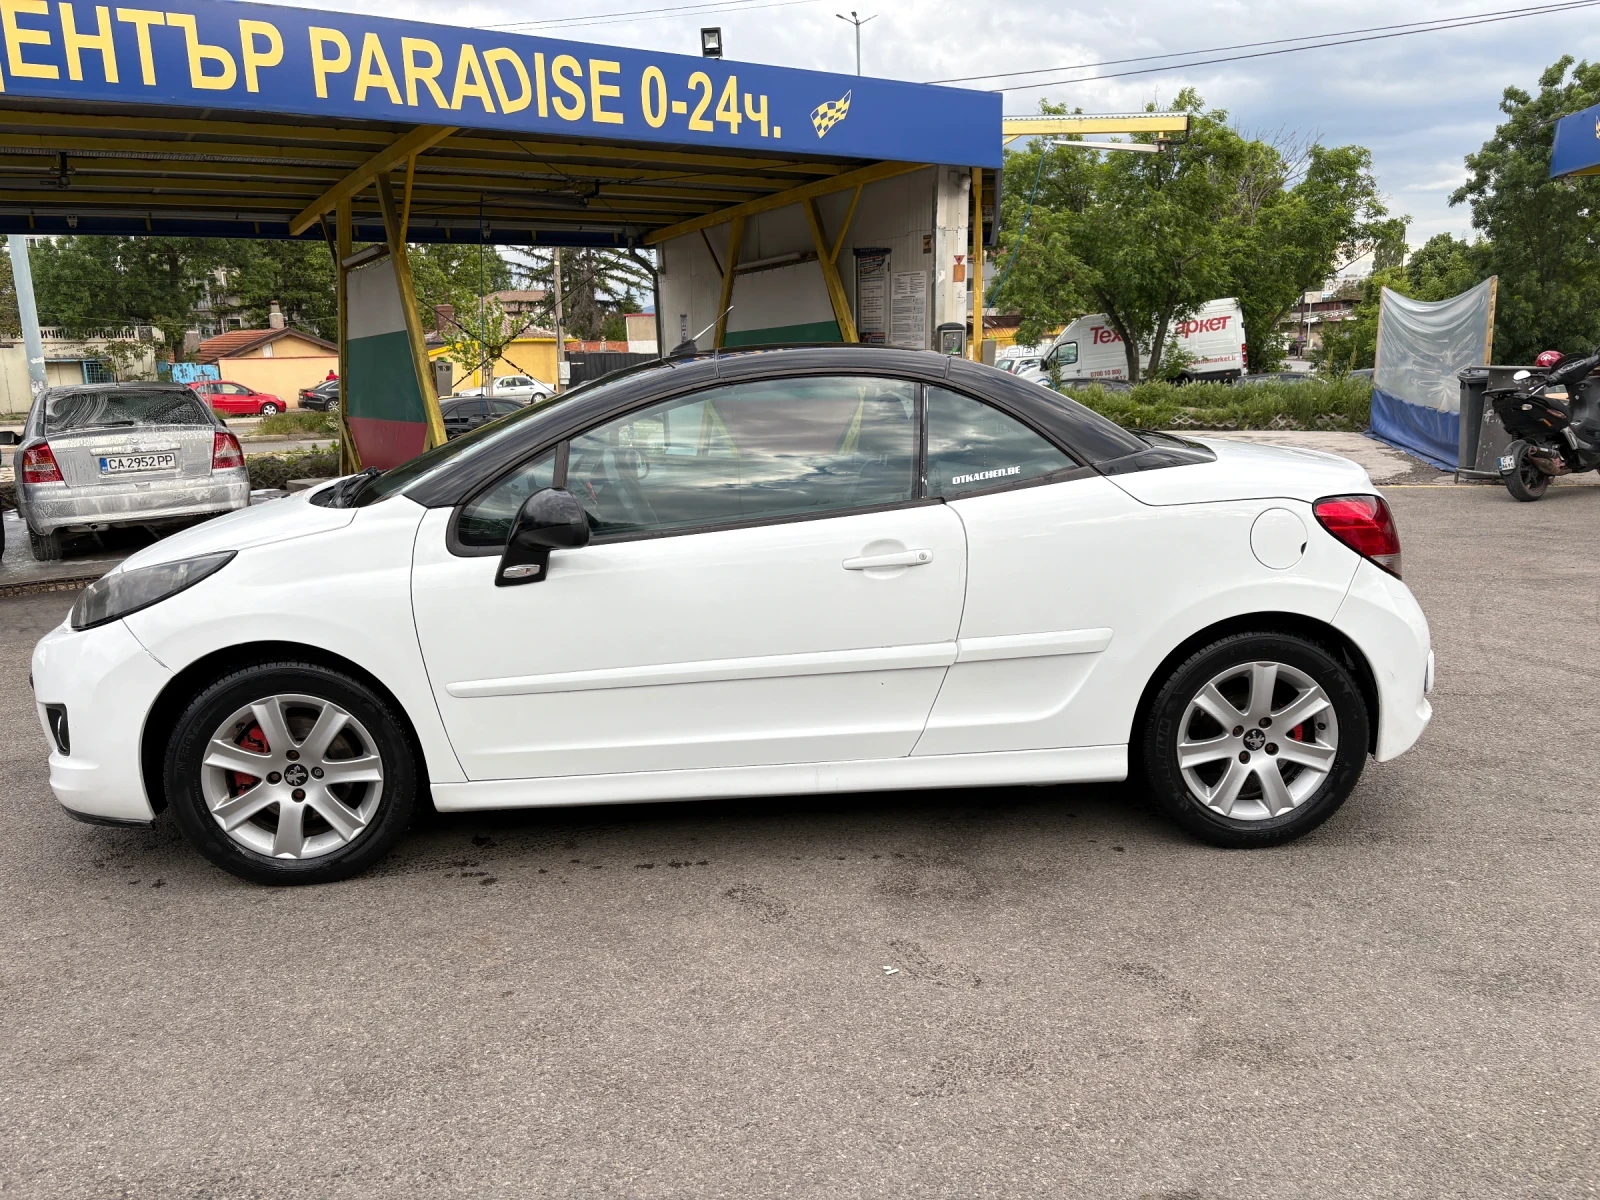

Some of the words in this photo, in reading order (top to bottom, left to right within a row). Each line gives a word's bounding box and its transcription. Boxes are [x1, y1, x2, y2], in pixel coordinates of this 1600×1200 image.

[0, 0, 284, 93] ЕНТЪР
[309, 26, 623, 124] PARADISE
[641, 65, 781, 138] 0-24ч.
[1090, 315, 1231, 345] Техаркет
[108, 458, 125, 470] CA
[126, 456, 156, 469] 2952
[157, 454, 173, 466] PP
[952, 465, 1021, 485] OTKACHEN.BE
